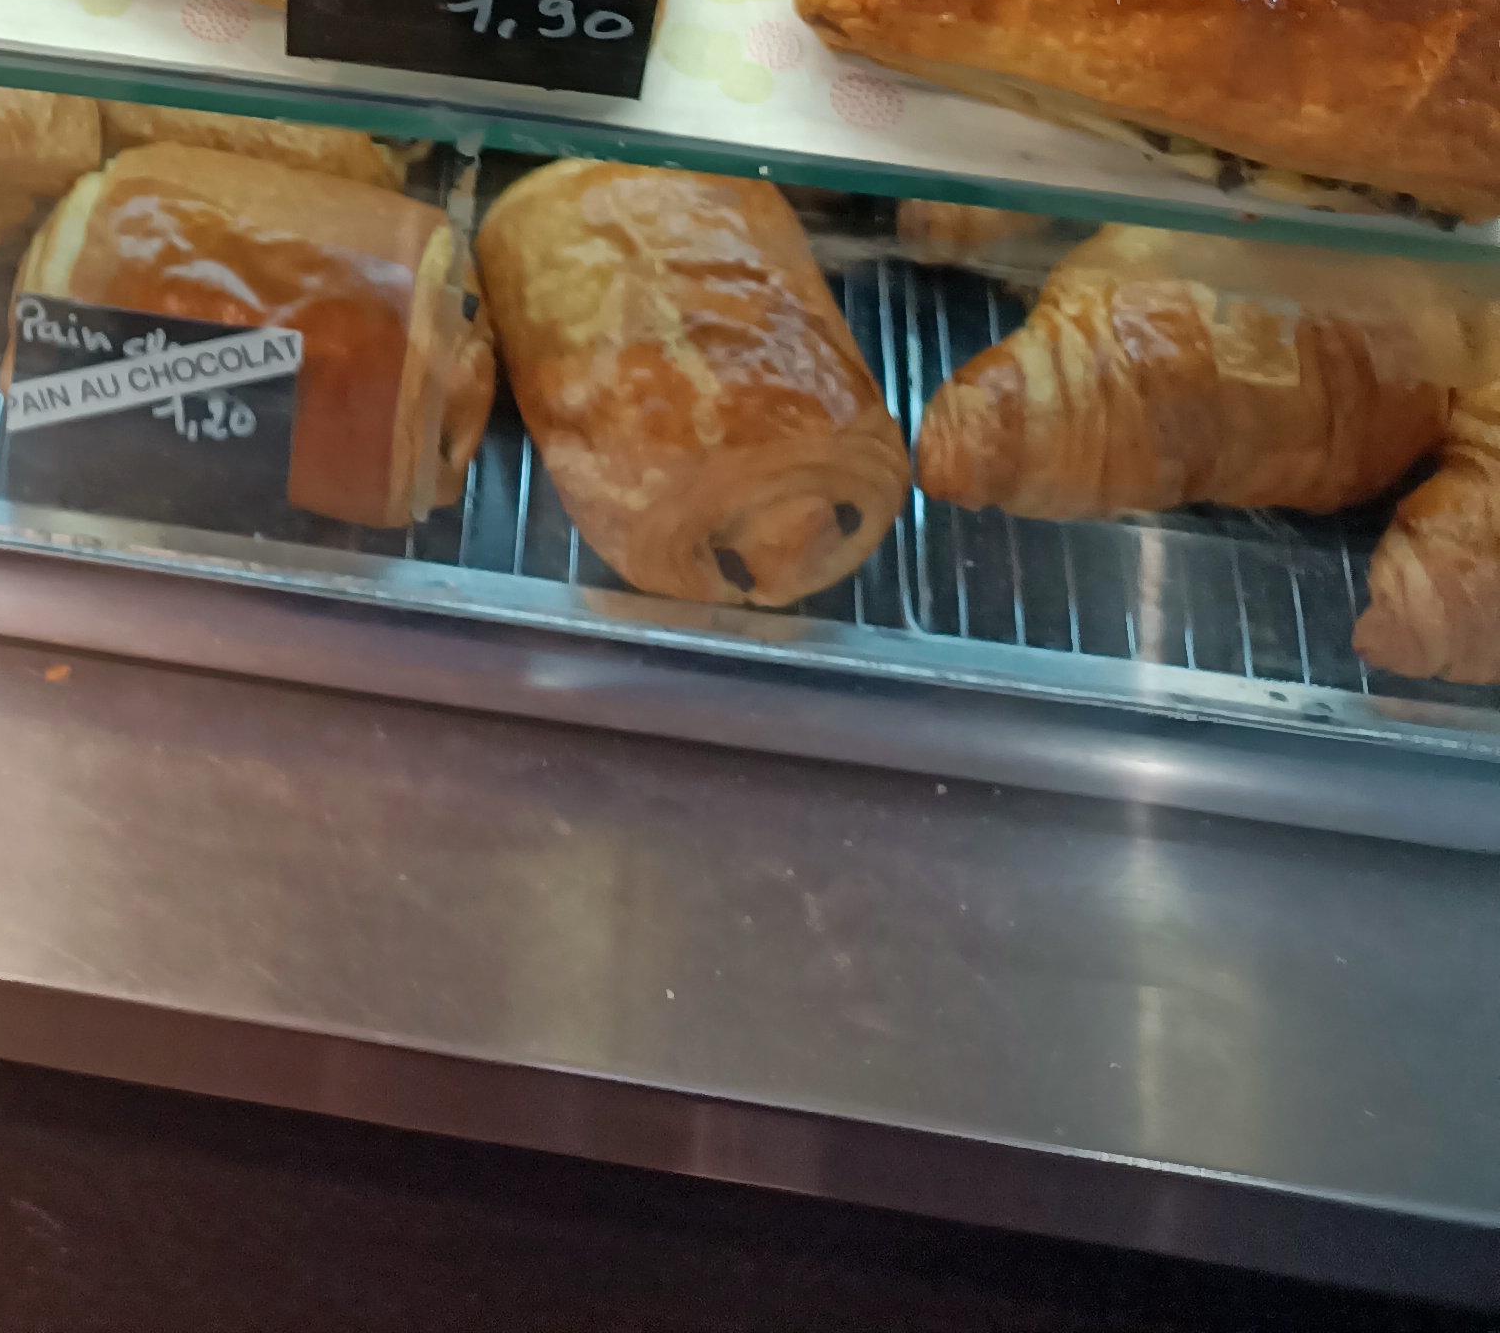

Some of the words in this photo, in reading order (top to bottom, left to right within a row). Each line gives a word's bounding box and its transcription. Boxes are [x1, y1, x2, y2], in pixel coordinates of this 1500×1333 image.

[16, 298, 113, 353] Pain
[80, 376, 122, 404] AU
[127, 335, 300, 393] CHOCOLAT
